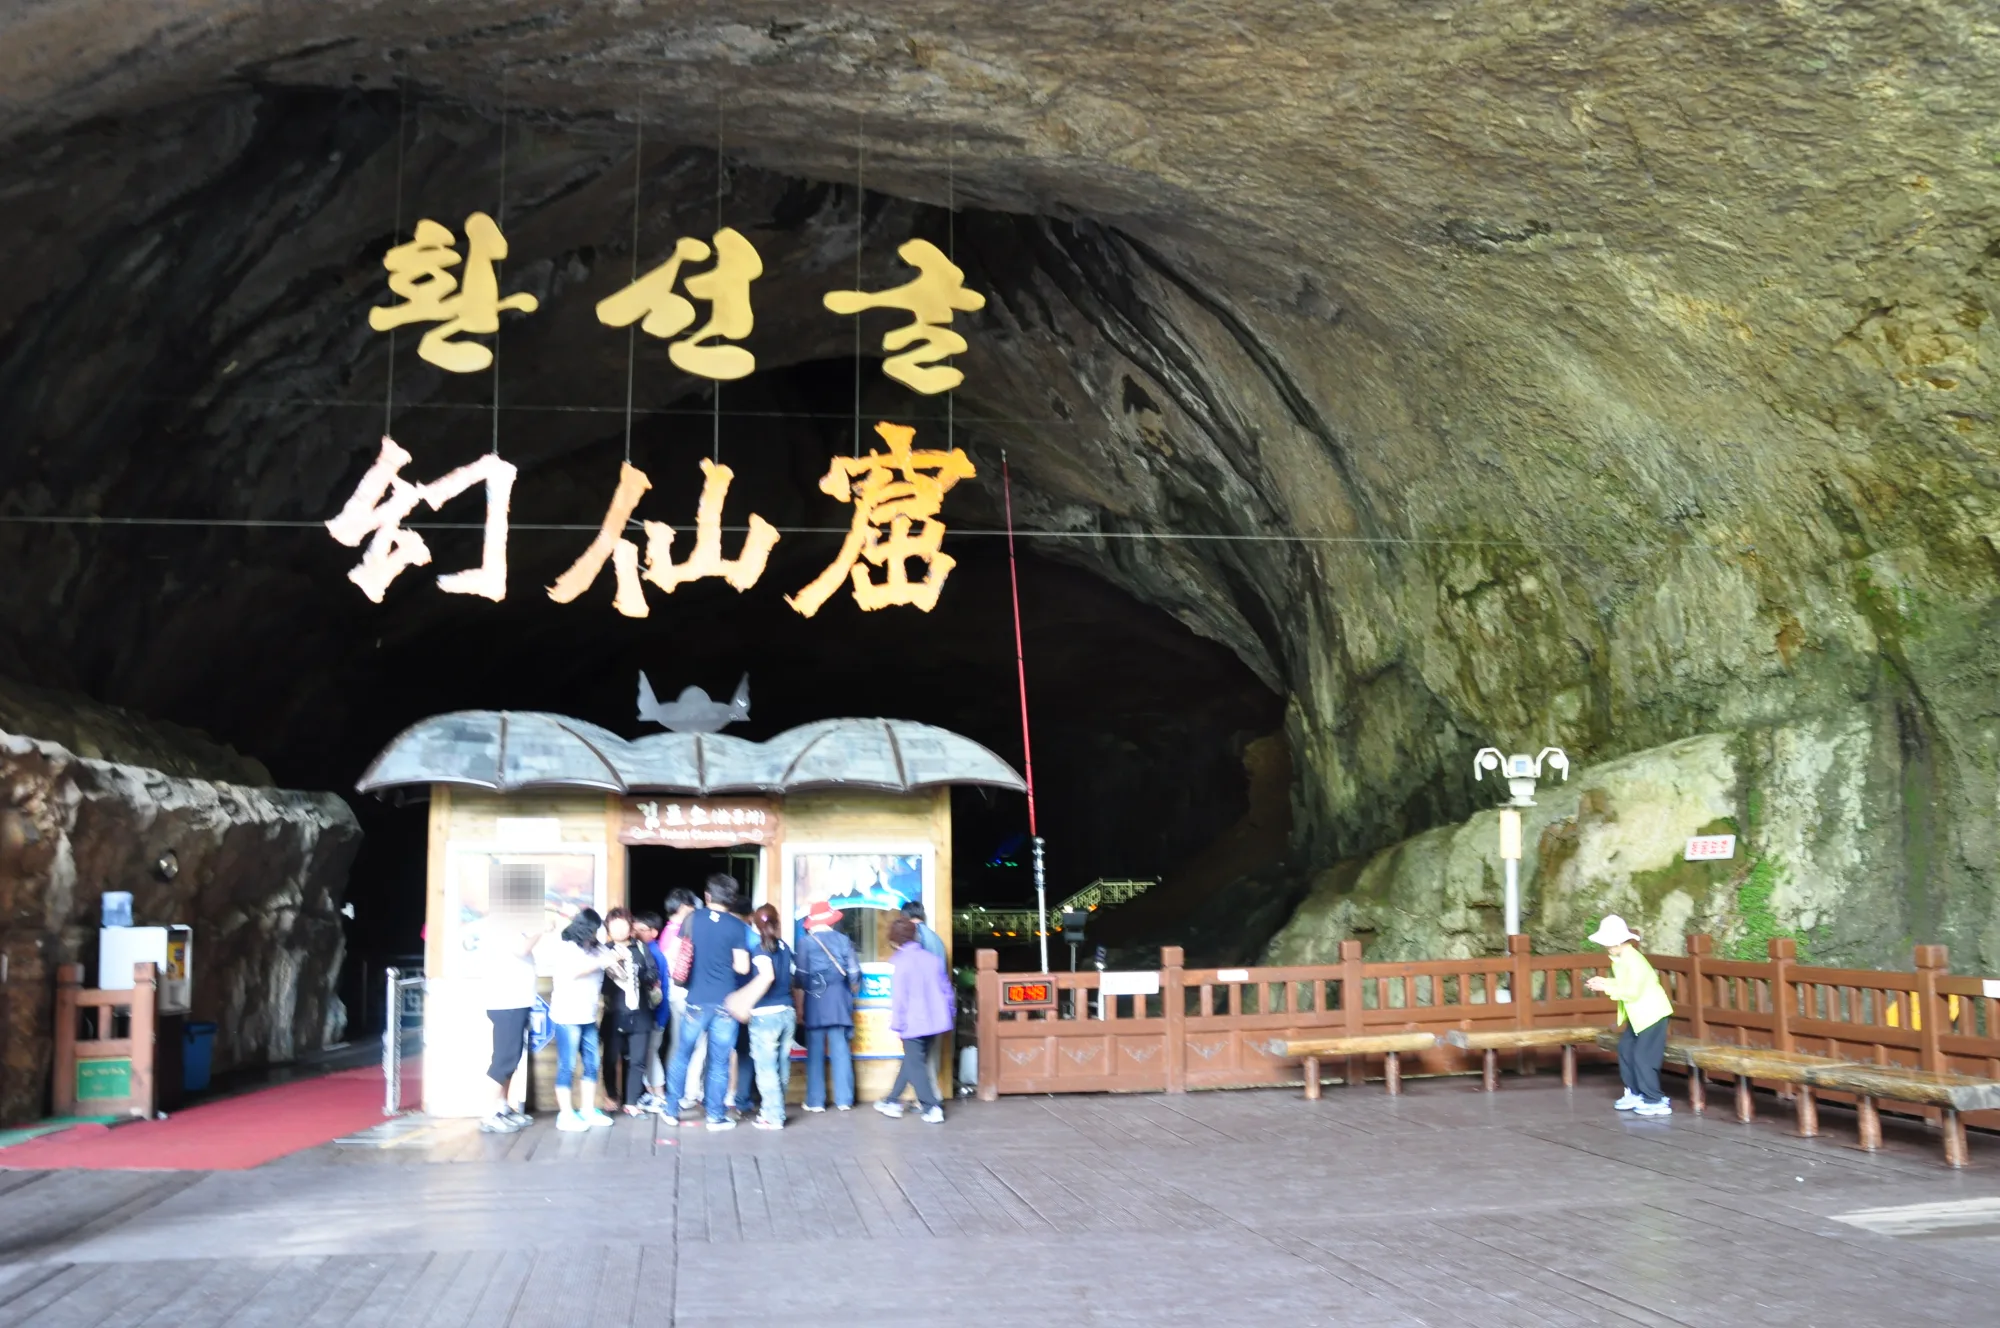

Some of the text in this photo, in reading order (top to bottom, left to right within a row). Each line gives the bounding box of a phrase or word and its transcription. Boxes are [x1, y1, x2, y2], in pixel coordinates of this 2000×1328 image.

[368, 211, 986, 395] 환선굴
[325, 421, 976, 618] 幻仙窟
